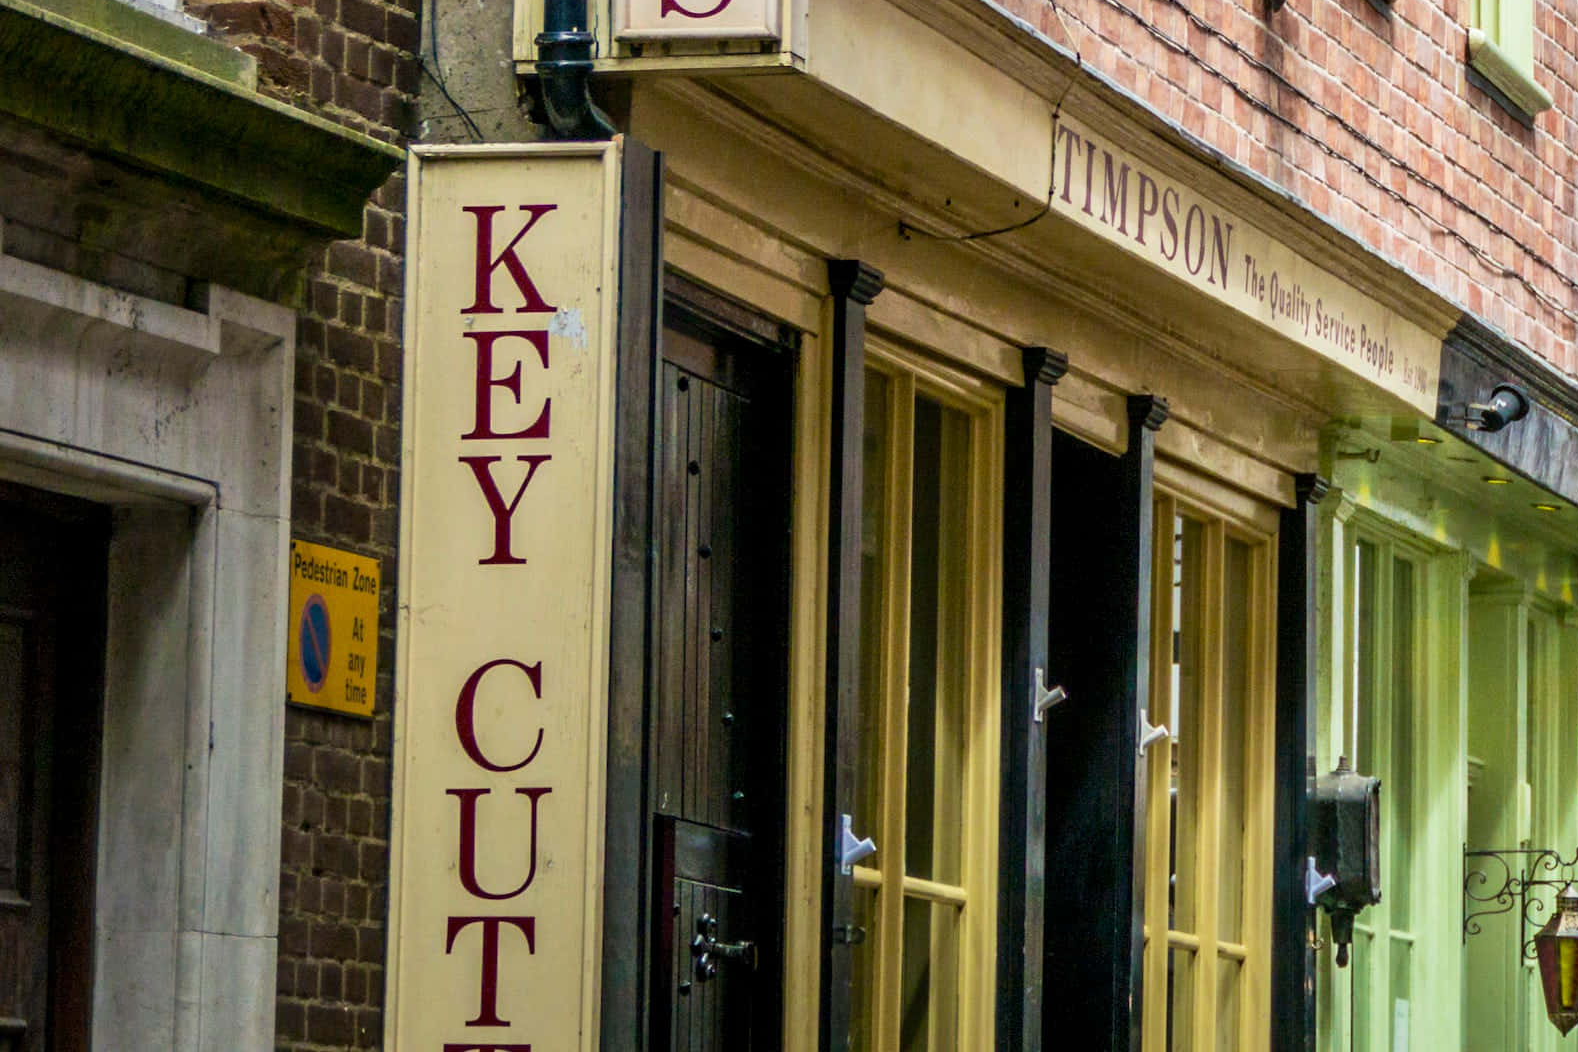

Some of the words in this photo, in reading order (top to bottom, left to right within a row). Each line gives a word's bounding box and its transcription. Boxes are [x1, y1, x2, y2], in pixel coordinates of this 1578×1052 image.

[1057, 124, 1234, 291] TIMPSON
[1245, 254, 1265, 302] The
[1270, 270, 1311, 337] Quality
[1315, 298, 1356, 354] Service
[1360, 324, 1394, 379] People
[457, 204, 559, 566] KEY
[294, 553, 348, 589] Pedestrian
[352, 566, 376, 595] Zone
[352, 617, 364, 643] At
[348, 652, 366, 678] any
[345, 678, 367, 705] time
[443, 658, 554, 1052] CUT
